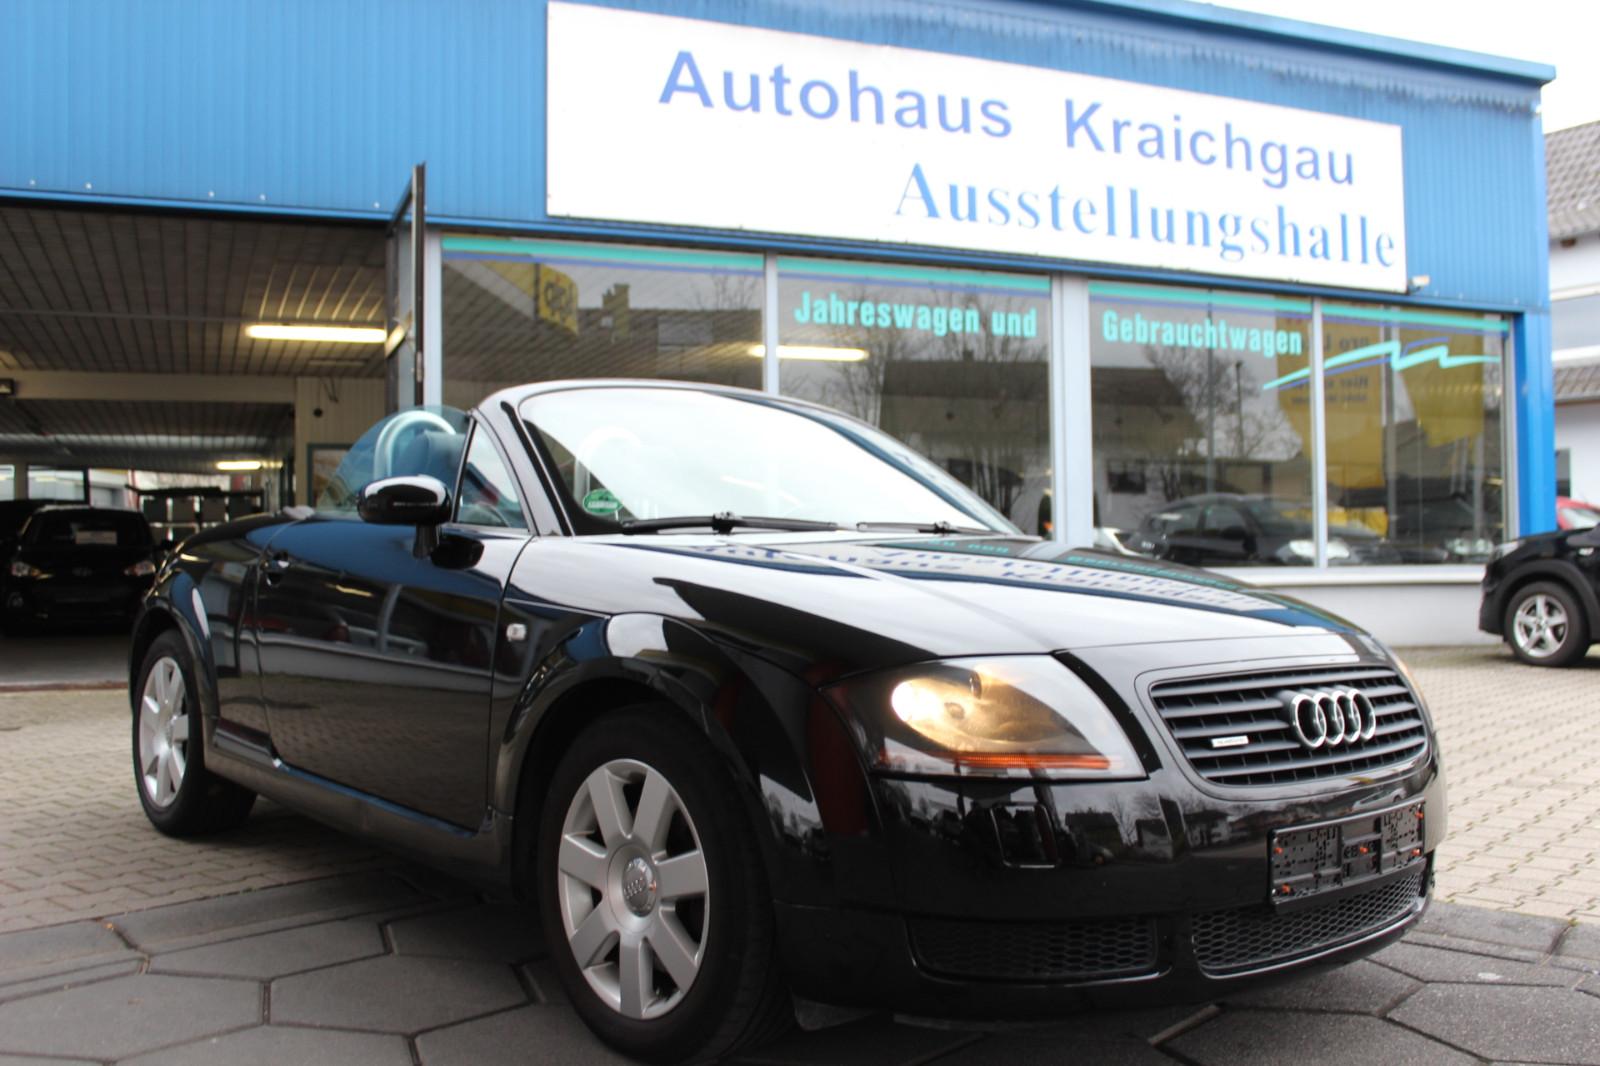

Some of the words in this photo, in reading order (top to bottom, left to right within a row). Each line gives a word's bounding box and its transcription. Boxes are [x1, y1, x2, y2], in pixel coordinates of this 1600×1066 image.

[659, 49, 1013, 139] Autohaus
[1065, 97, 1354, 190] Kraichgau
[895, 162, 1394, 268] Ausstellungshalle
[794, 291, 980, 337] Jahreswagen
[991, 307, 1037, 338] und
[1103, 309, 1302, 358] Gebrauchtwagen
